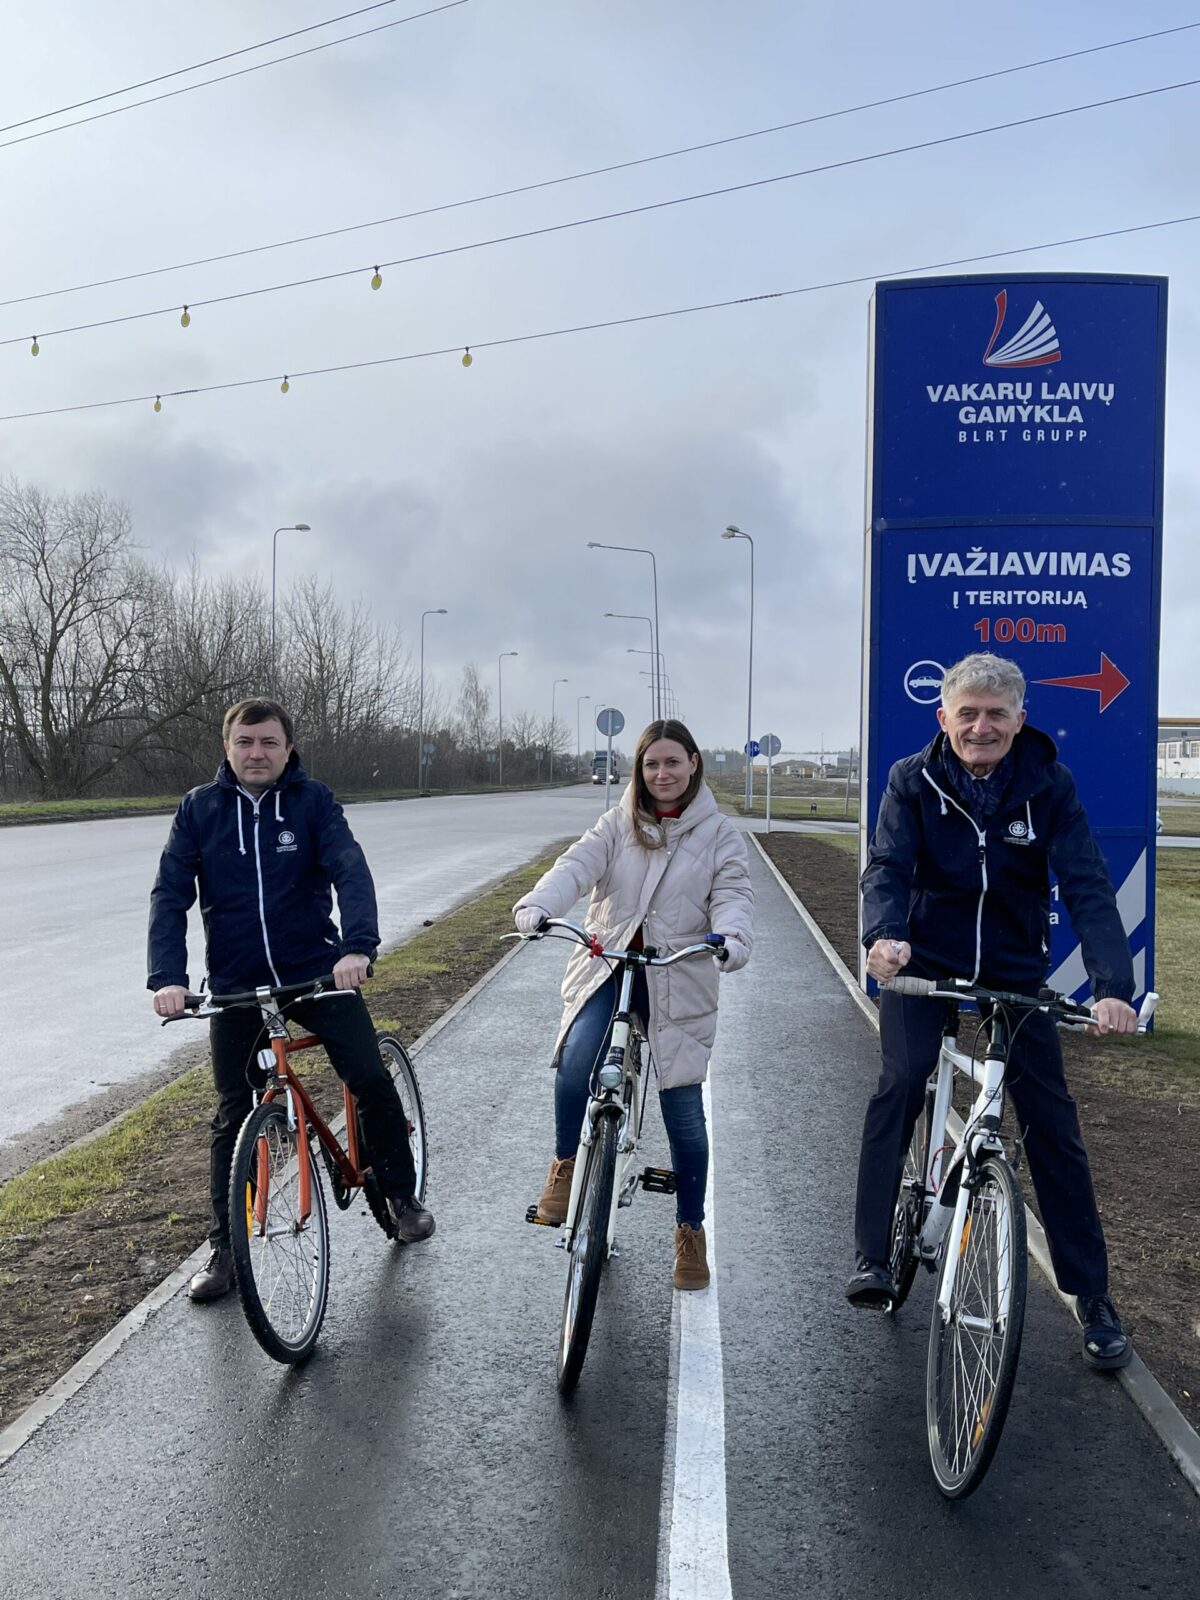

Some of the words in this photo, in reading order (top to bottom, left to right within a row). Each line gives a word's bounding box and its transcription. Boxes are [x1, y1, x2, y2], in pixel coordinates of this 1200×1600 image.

[926, 382, 1033, 404] VAKARŲ
[1041, 382, 1115, 406] LAIVŲ
[958, 405, 1084, 424] GAMYKLA
[958, 430, 1008, 443] BLRT
[1022, 429, 1088, 442] GRUPP
[907, 546, 1132, 584] ĮVAŽIAVIMAS
[965, 590, 1088, 609] TERITORIJĄ
[974, 617, 1067, 643] 100m
